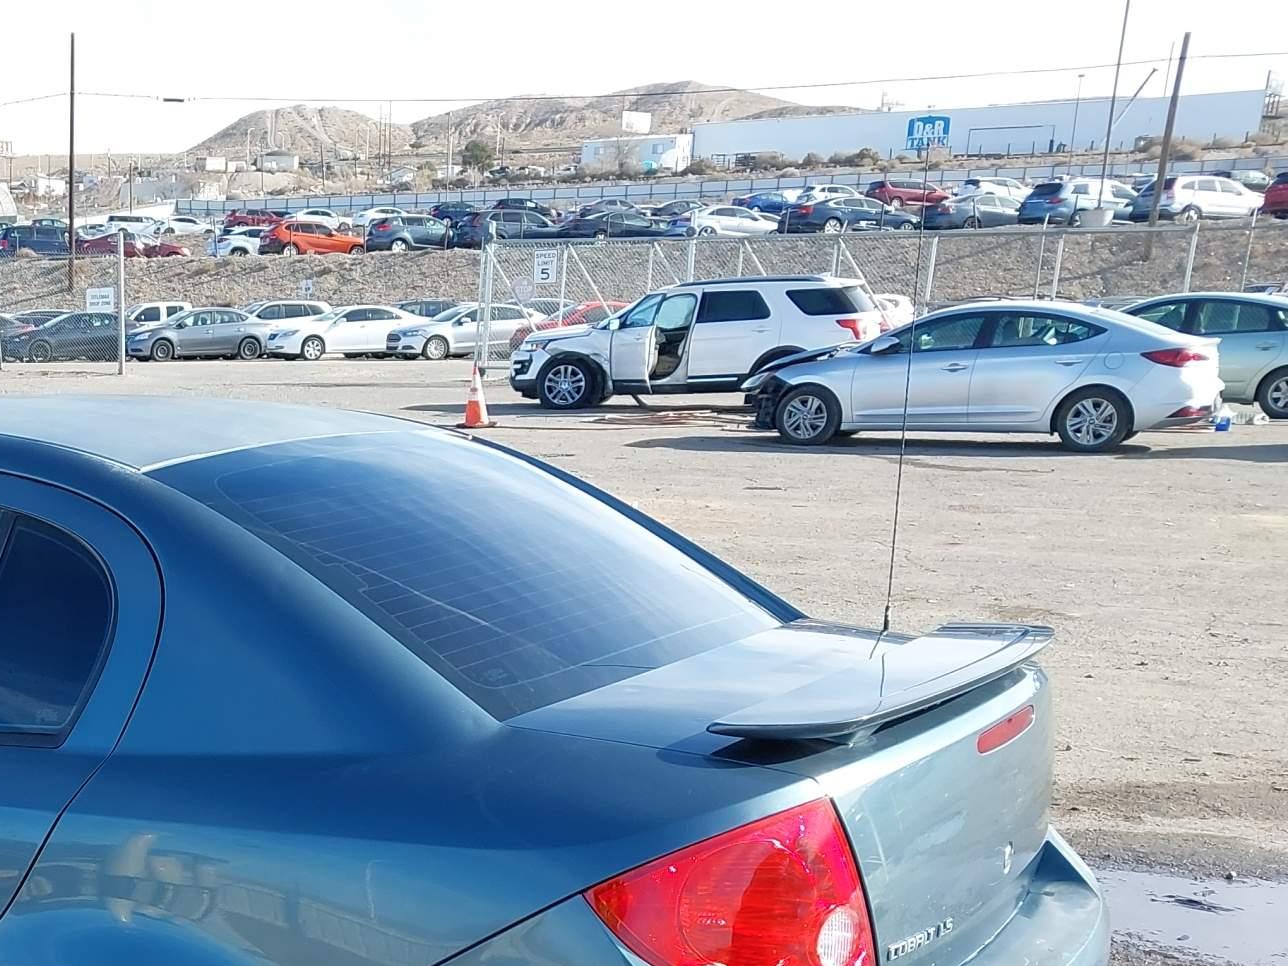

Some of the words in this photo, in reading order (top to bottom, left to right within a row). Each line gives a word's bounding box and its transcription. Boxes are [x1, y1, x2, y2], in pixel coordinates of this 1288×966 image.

[914, 120, 945, 136] D&R
[908, 136, 947, 148] TANK
[540, 267, 550, 281] 5
[887, 927, 936, 962] COBALT
[936, 917, 953, 937] LS
